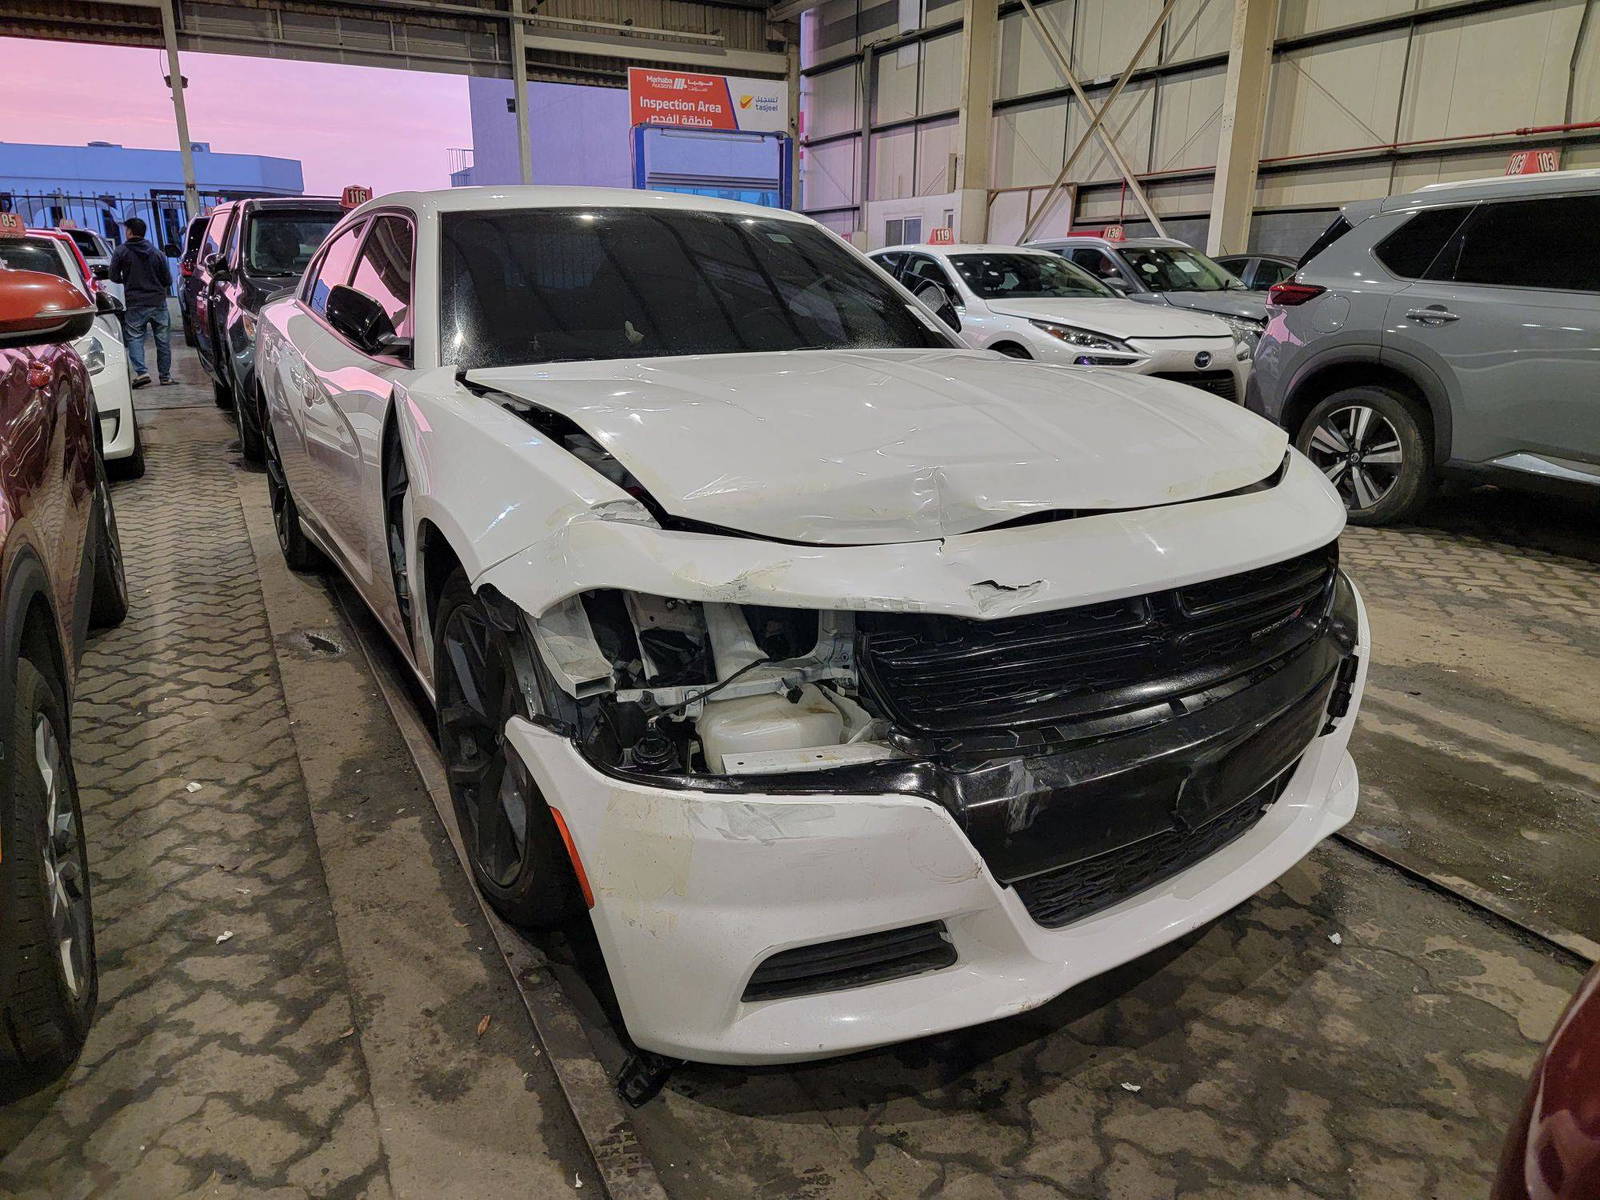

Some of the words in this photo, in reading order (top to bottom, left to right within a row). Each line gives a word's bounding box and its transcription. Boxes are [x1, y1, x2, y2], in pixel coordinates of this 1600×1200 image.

[640, 96, 696, 111] Inspection
[697, 101, 722, 113] Area
[756, 104, 778, 112] tasjeel
[681, 115, 713, 127] منطقة
[1507, 154, 1526, 175] 103
[1538, 152, 1555, 172] 103
[349, 190, 366, 203] 116
[1, 213, 17, 227] 85
[936, 229, 950, 241] 119
